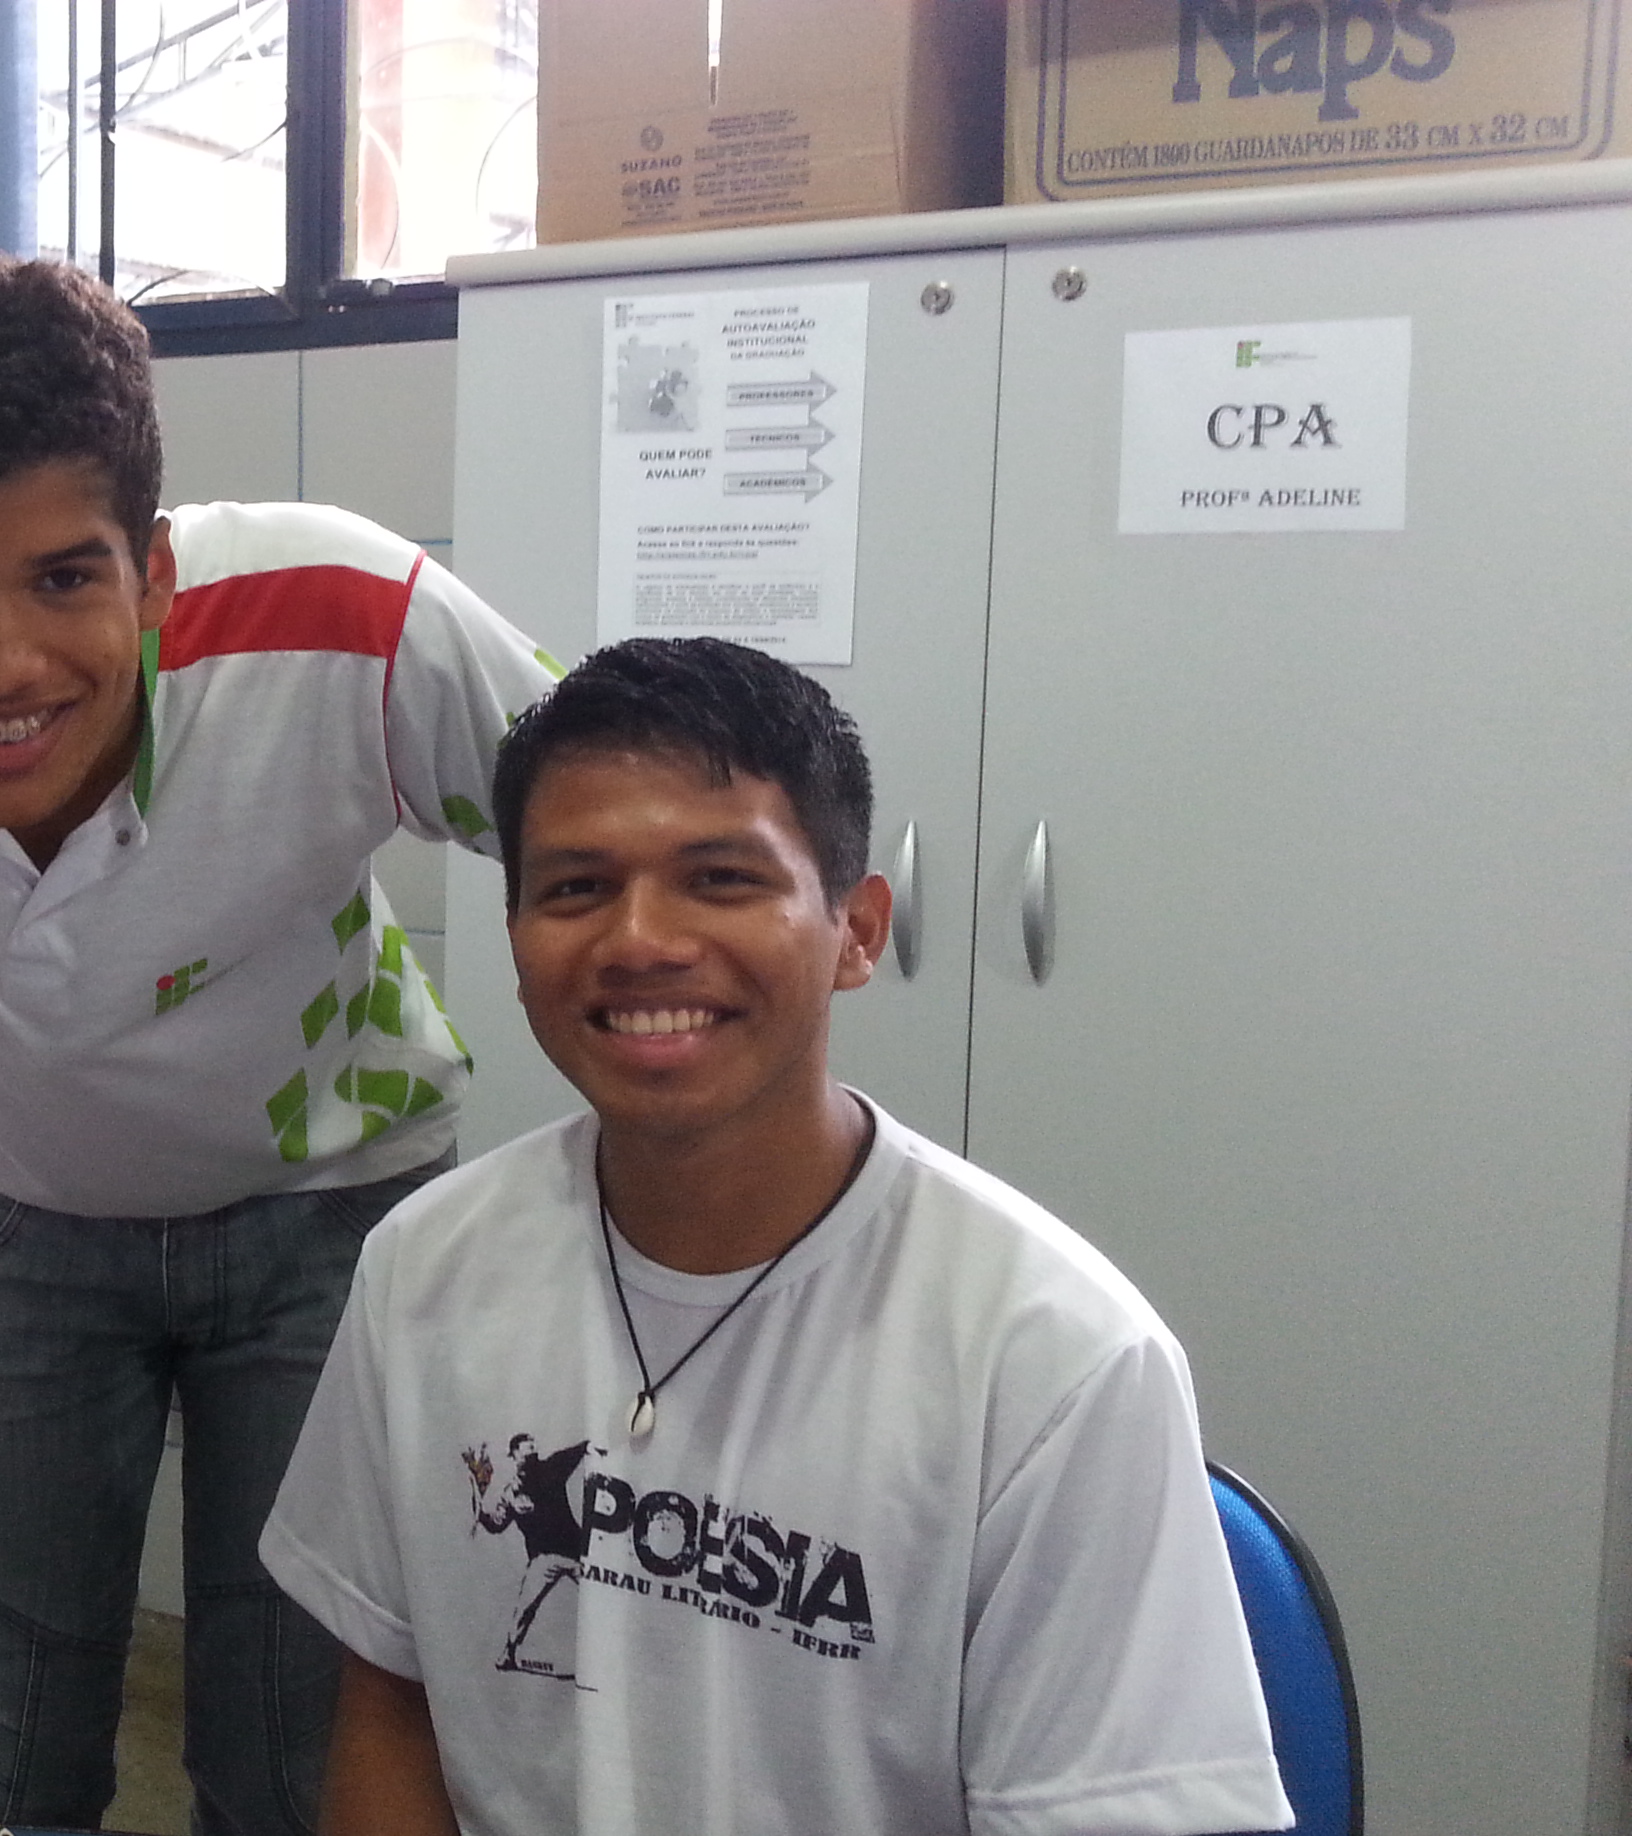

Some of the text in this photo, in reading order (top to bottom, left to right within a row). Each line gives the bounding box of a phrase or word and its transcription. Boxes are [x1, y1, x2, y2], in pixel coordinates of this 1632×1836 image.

[1172, 0, 1455, 122] Naps
[1067, 141, 1149, 174] CONTÉM
[1194, 131, 1344, 162] GUARDANAPOS
[1350, 128, 1380, 152] DE
[1385, 122, 1419, 151] 33
[1427, 124, 1460, 147] CM
[1490, 113, 1527, 143] 32
[1535, 115, 1569, 139] CM
[721, 319, 816, 335] AUTOAVALIAÇÃO
[726, 335, 807, 347] INSTITUCIONAL
[745, 347, 805, 360] GRADUAÇÃO
[1206, 400, 1343, 450] CPA
[639, 449, 713, 461] QUEM PODE
[645, 468, 706, 480] AVALIAR?
[1258, 487, 1362, 508] ADELINE
[637, 525, 665, 535] COMO
[666, 524, 718, 534] PARTICIPAR
[583, 1471, 875, 1629] POESIA
